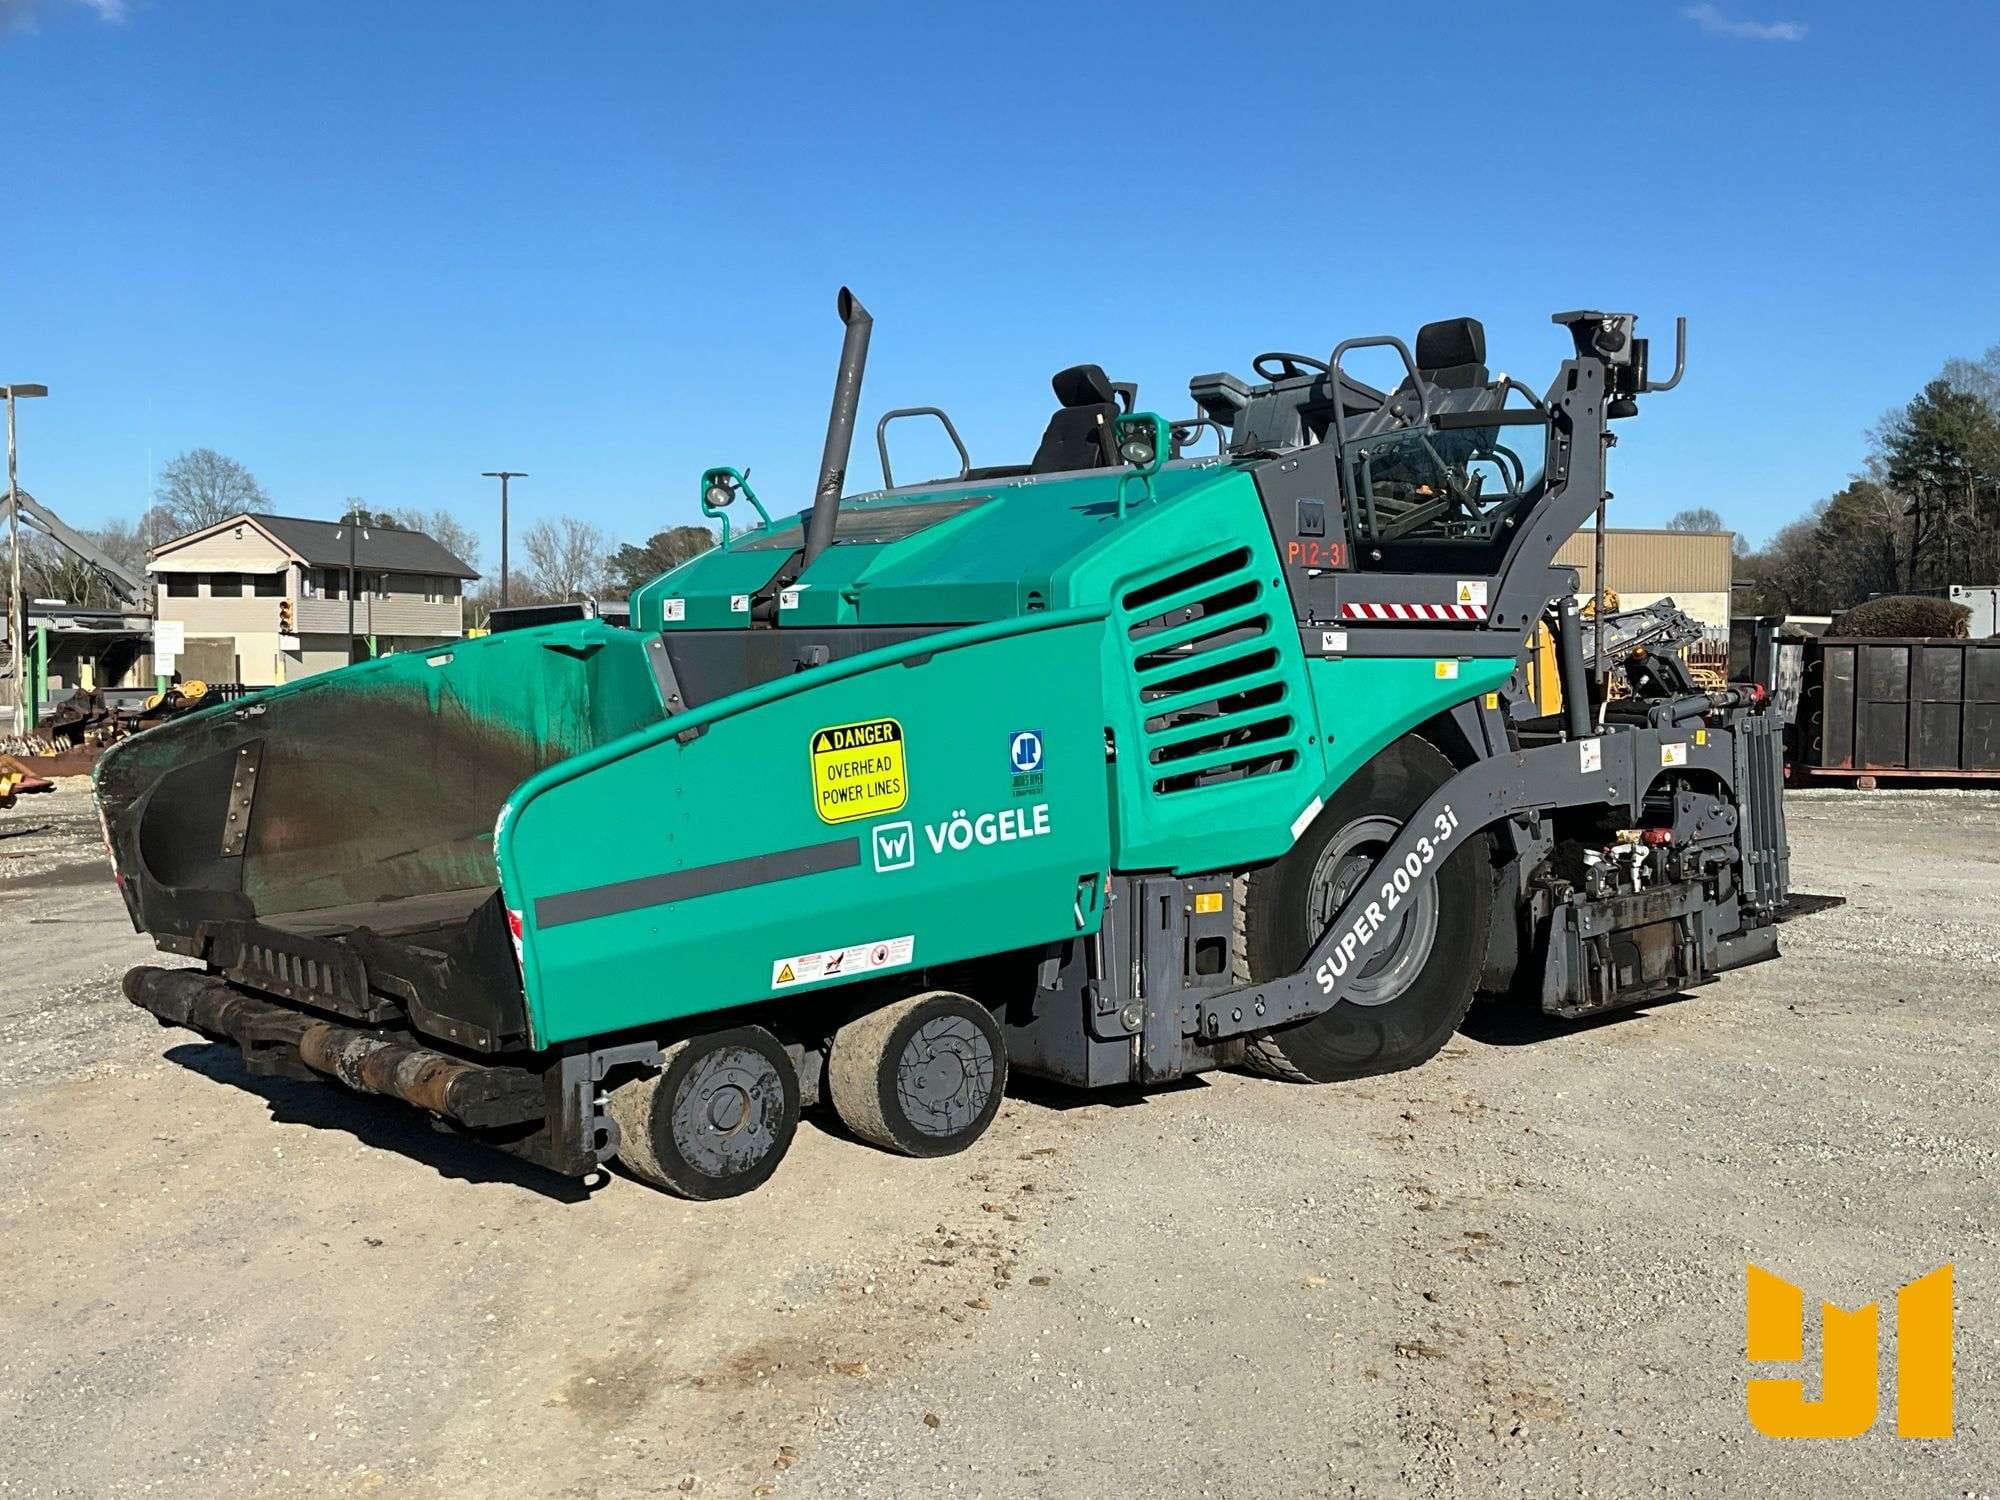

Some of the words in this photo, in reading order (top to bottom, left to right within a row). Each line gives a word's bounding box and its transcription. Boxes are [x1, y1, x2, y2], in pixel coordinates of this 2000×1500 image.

[834, 723, 893, 749] DANGER
[827, 756, 892, 781] OVERHEAD
[823, 784, 863, 806] POWER
[867, 778, 901, 798] LINES
[879, 832, 908, 860] W
[924, 803, 1051, 854] VÖGELE
[1315, 901, 1386, 994] SUPER
[1381, 804, 1458, 911] 2003-3i
